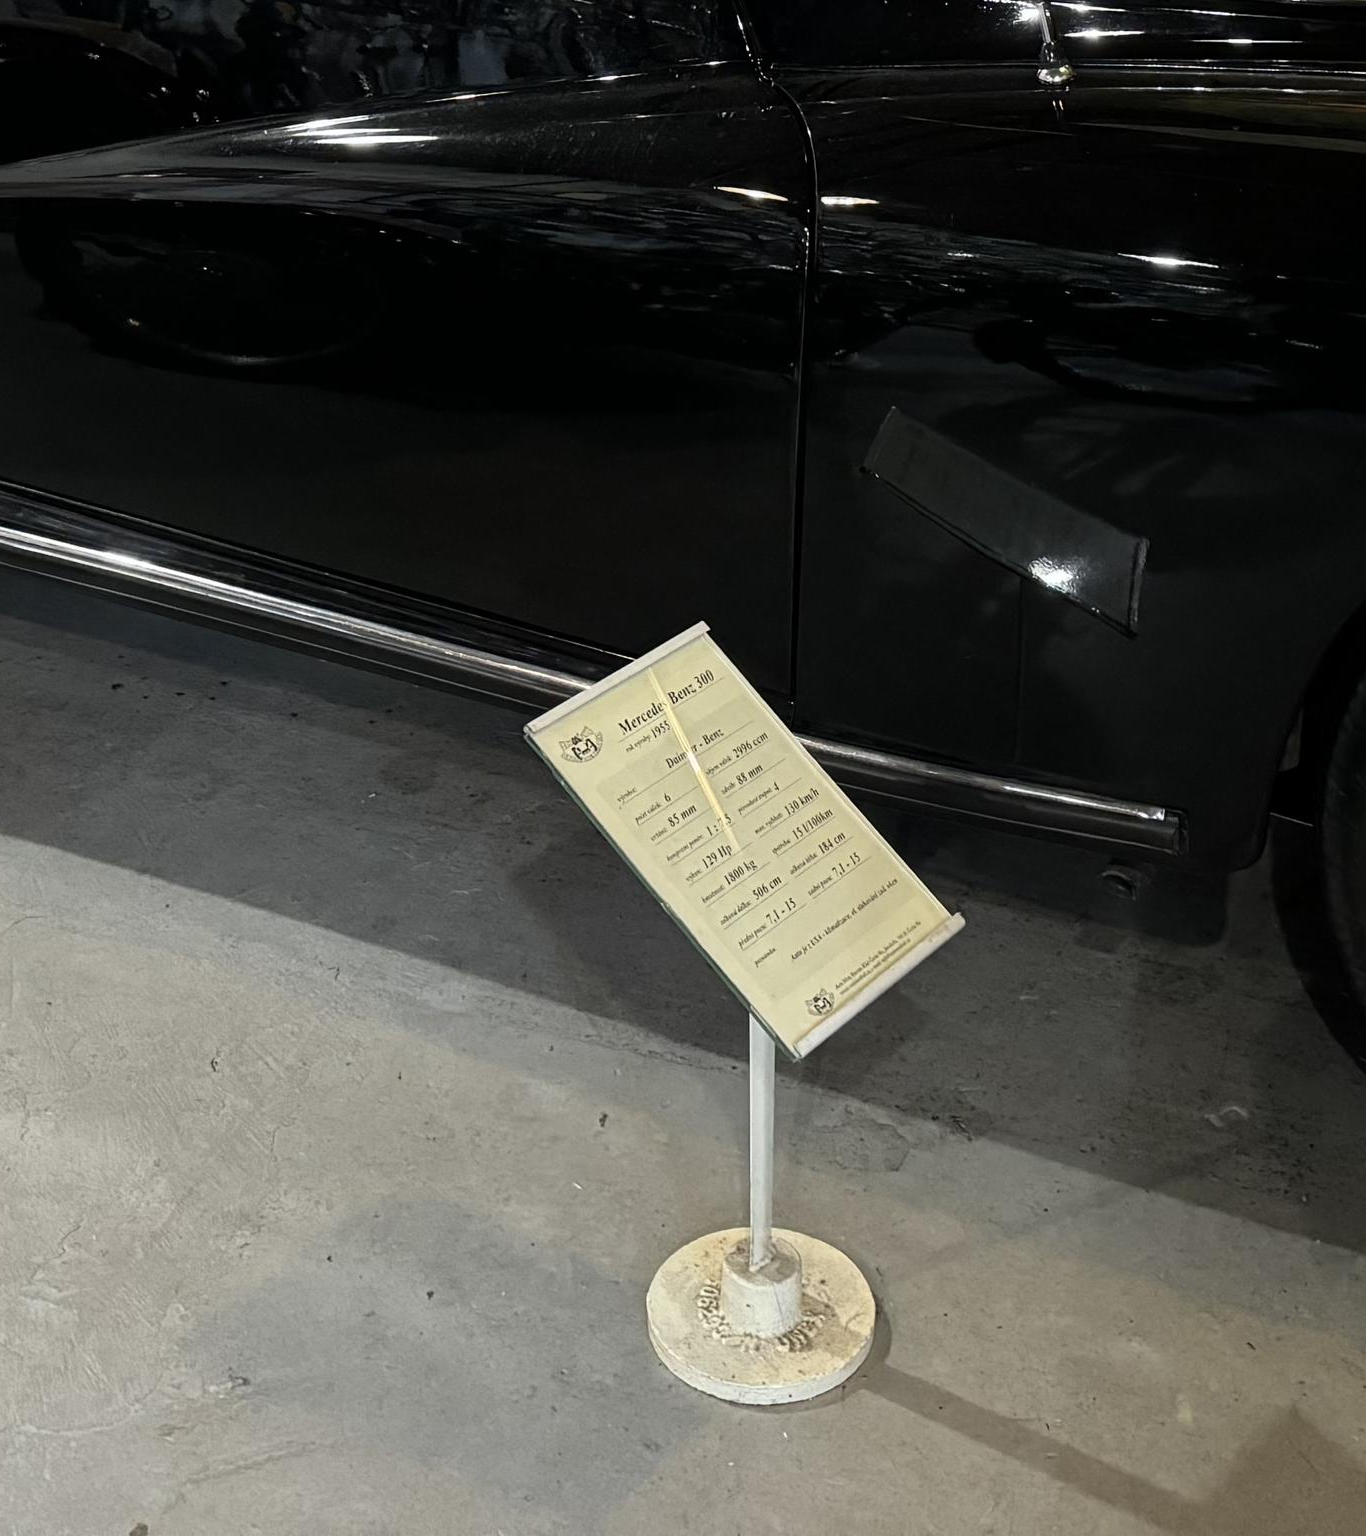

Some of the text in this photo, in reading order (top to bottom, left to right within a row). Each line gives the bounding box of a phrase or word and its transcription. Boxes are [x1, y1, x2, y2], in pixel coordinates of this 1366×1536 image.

[694, 670, 714, 689] 300
[651, 720, 670, 738] 1955
[665, 744, 698, 768] Daimr
[702, 729, 724, 745] Benz
[732, 740, 753, 758] 2996
[784, 800, 800, 816] 130
[798, 788, 819, 806] km/h
[680, 805, 697, 820] mm
[818, 838, 833, 854] 184
[702, 852, 717, 869] 129
[724, 865, 745, 885] 1800
[752, 883, 769, 900] 506
